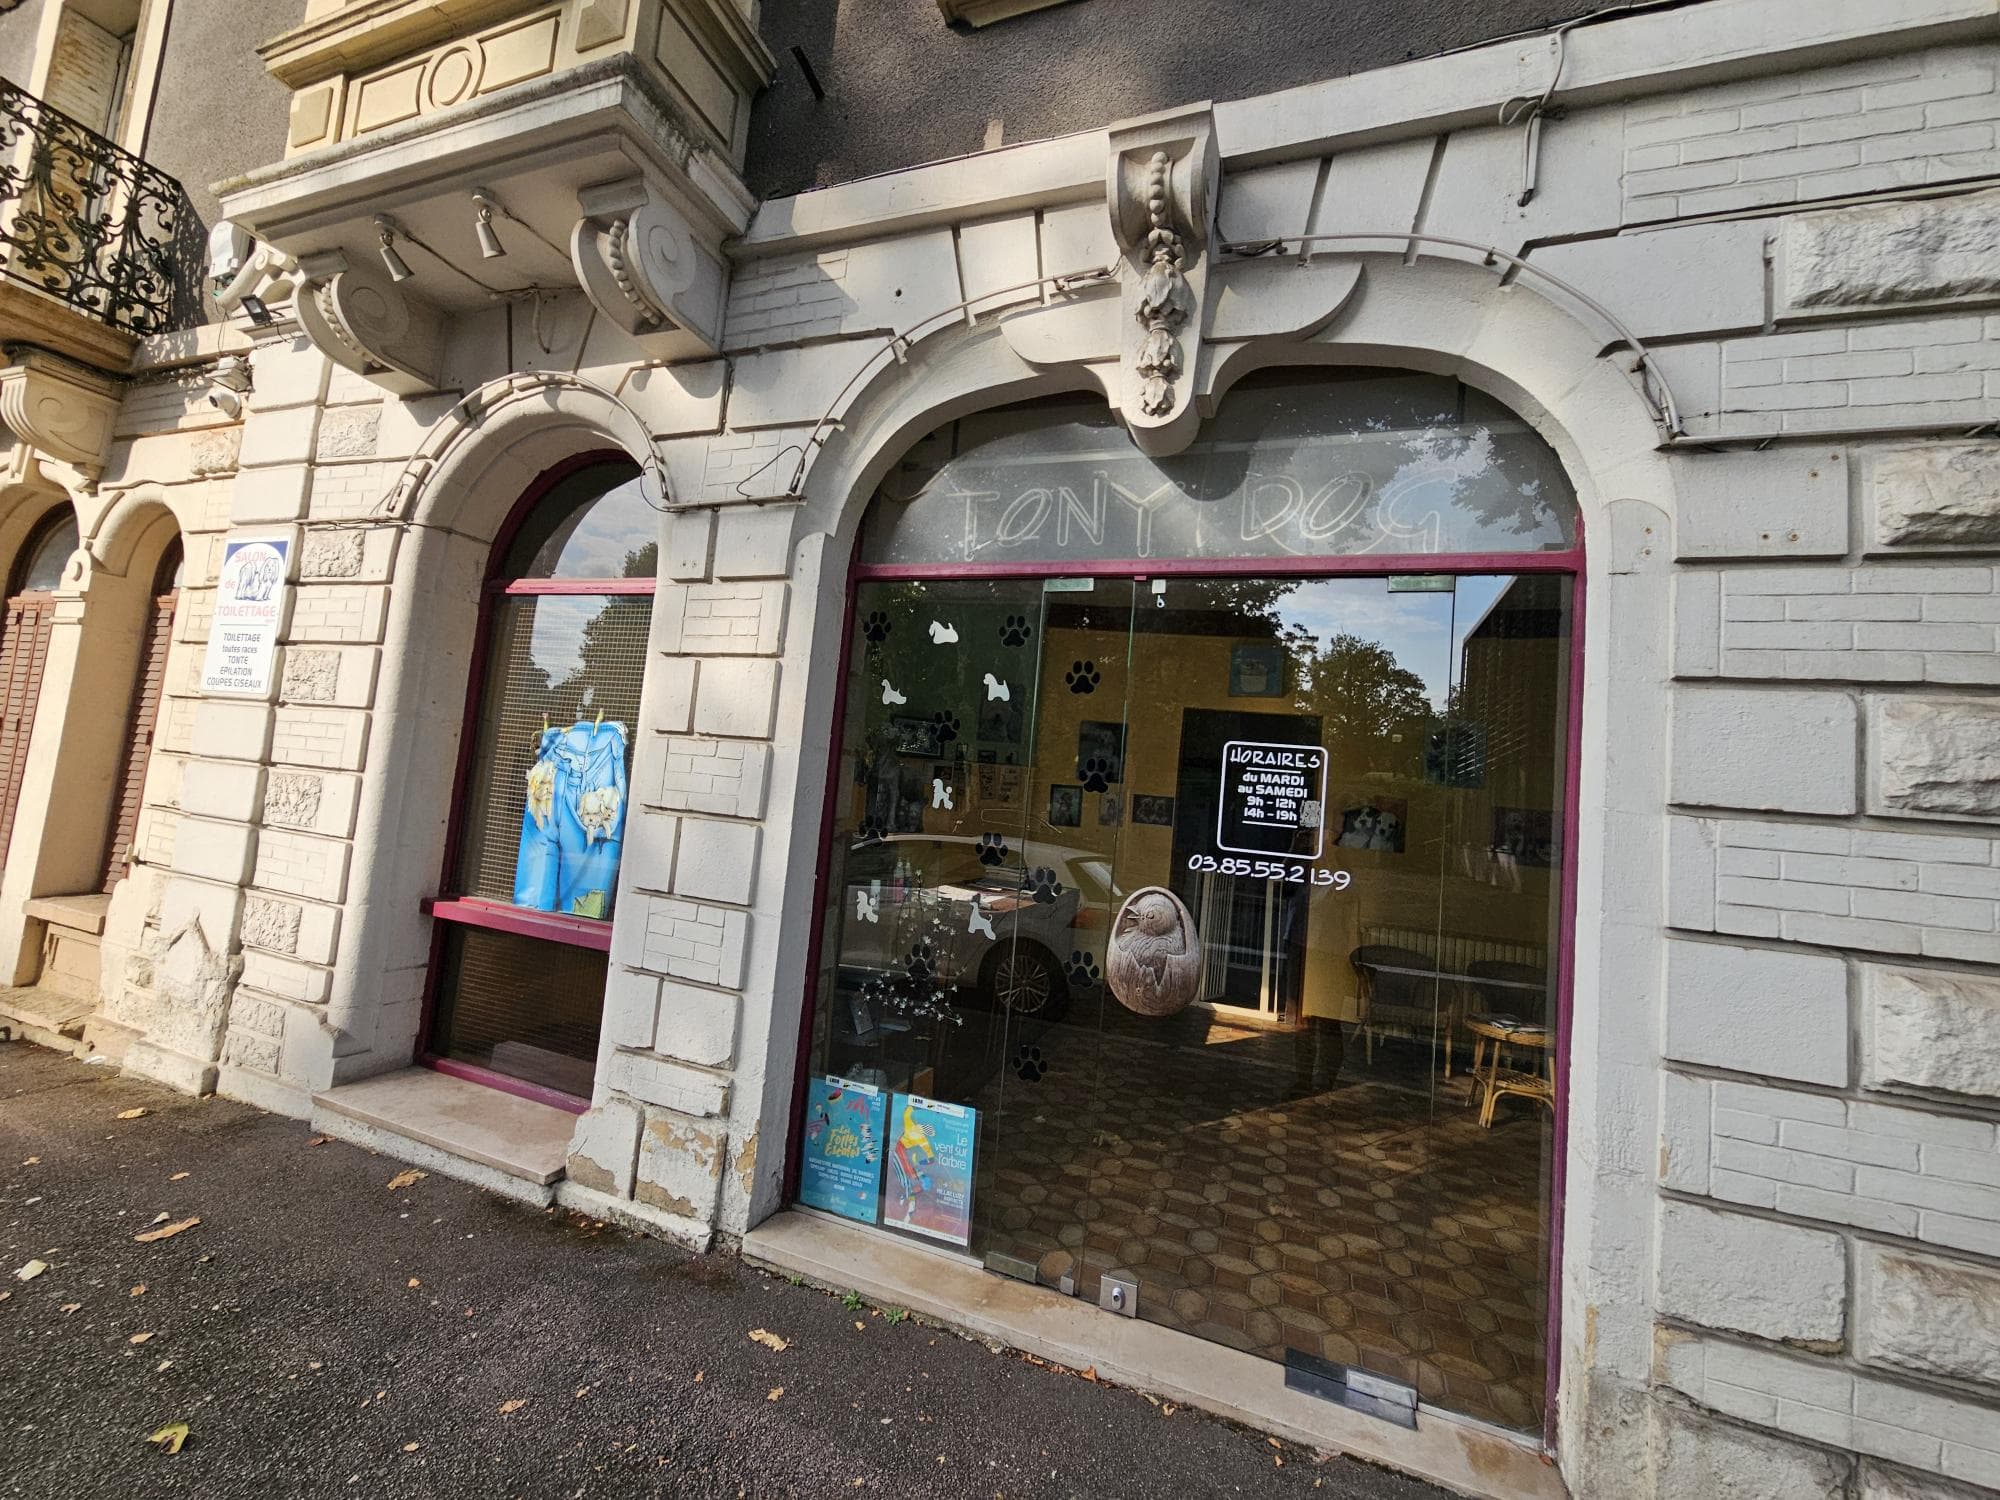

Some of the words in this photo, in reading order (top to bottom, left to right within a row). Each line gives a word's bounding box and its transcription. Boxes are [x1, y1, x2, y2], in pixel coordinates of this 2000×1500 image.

[946, 470, 1185, 562] TONY
[1240, 467, 1459, 554] DOG
[235, 551, 266, 563] SALON
[224, 579, 236, 589] de
[218, 605, 277, 618] TOILETTAGE
[223, 633, 262, 642] TOILETTAGE
[222, 645, 240, 653] toutes
[241, 646, 258, 654] races
[228, 656, 249, 665] TONTE
[206, 677, 233, 687] COUPES
[233, 679, 262, 689] CISEAUX
[1230, 748, 1321, 769] HORAIRES
[1242, 772, 1258, 782] du
[1260, 774, 1305, 786] MARDI
[1237, 785, 1253, 794] au
[1256, 786, 1308, 798] SAMEDI
[1247, 797, 1264, 807] 9h
[1275, 799, 1297, 810] 12h
[1243, 808, 1265, 819] 14h
[1276, 810, 1298, 822] 19h
[957, 1134, 968, 1147] Le
[934, 1142, 953, 1155] vent
[954, 1148, 968, 1158] sur
[938, 1154, 967, 1170] l'arbre
